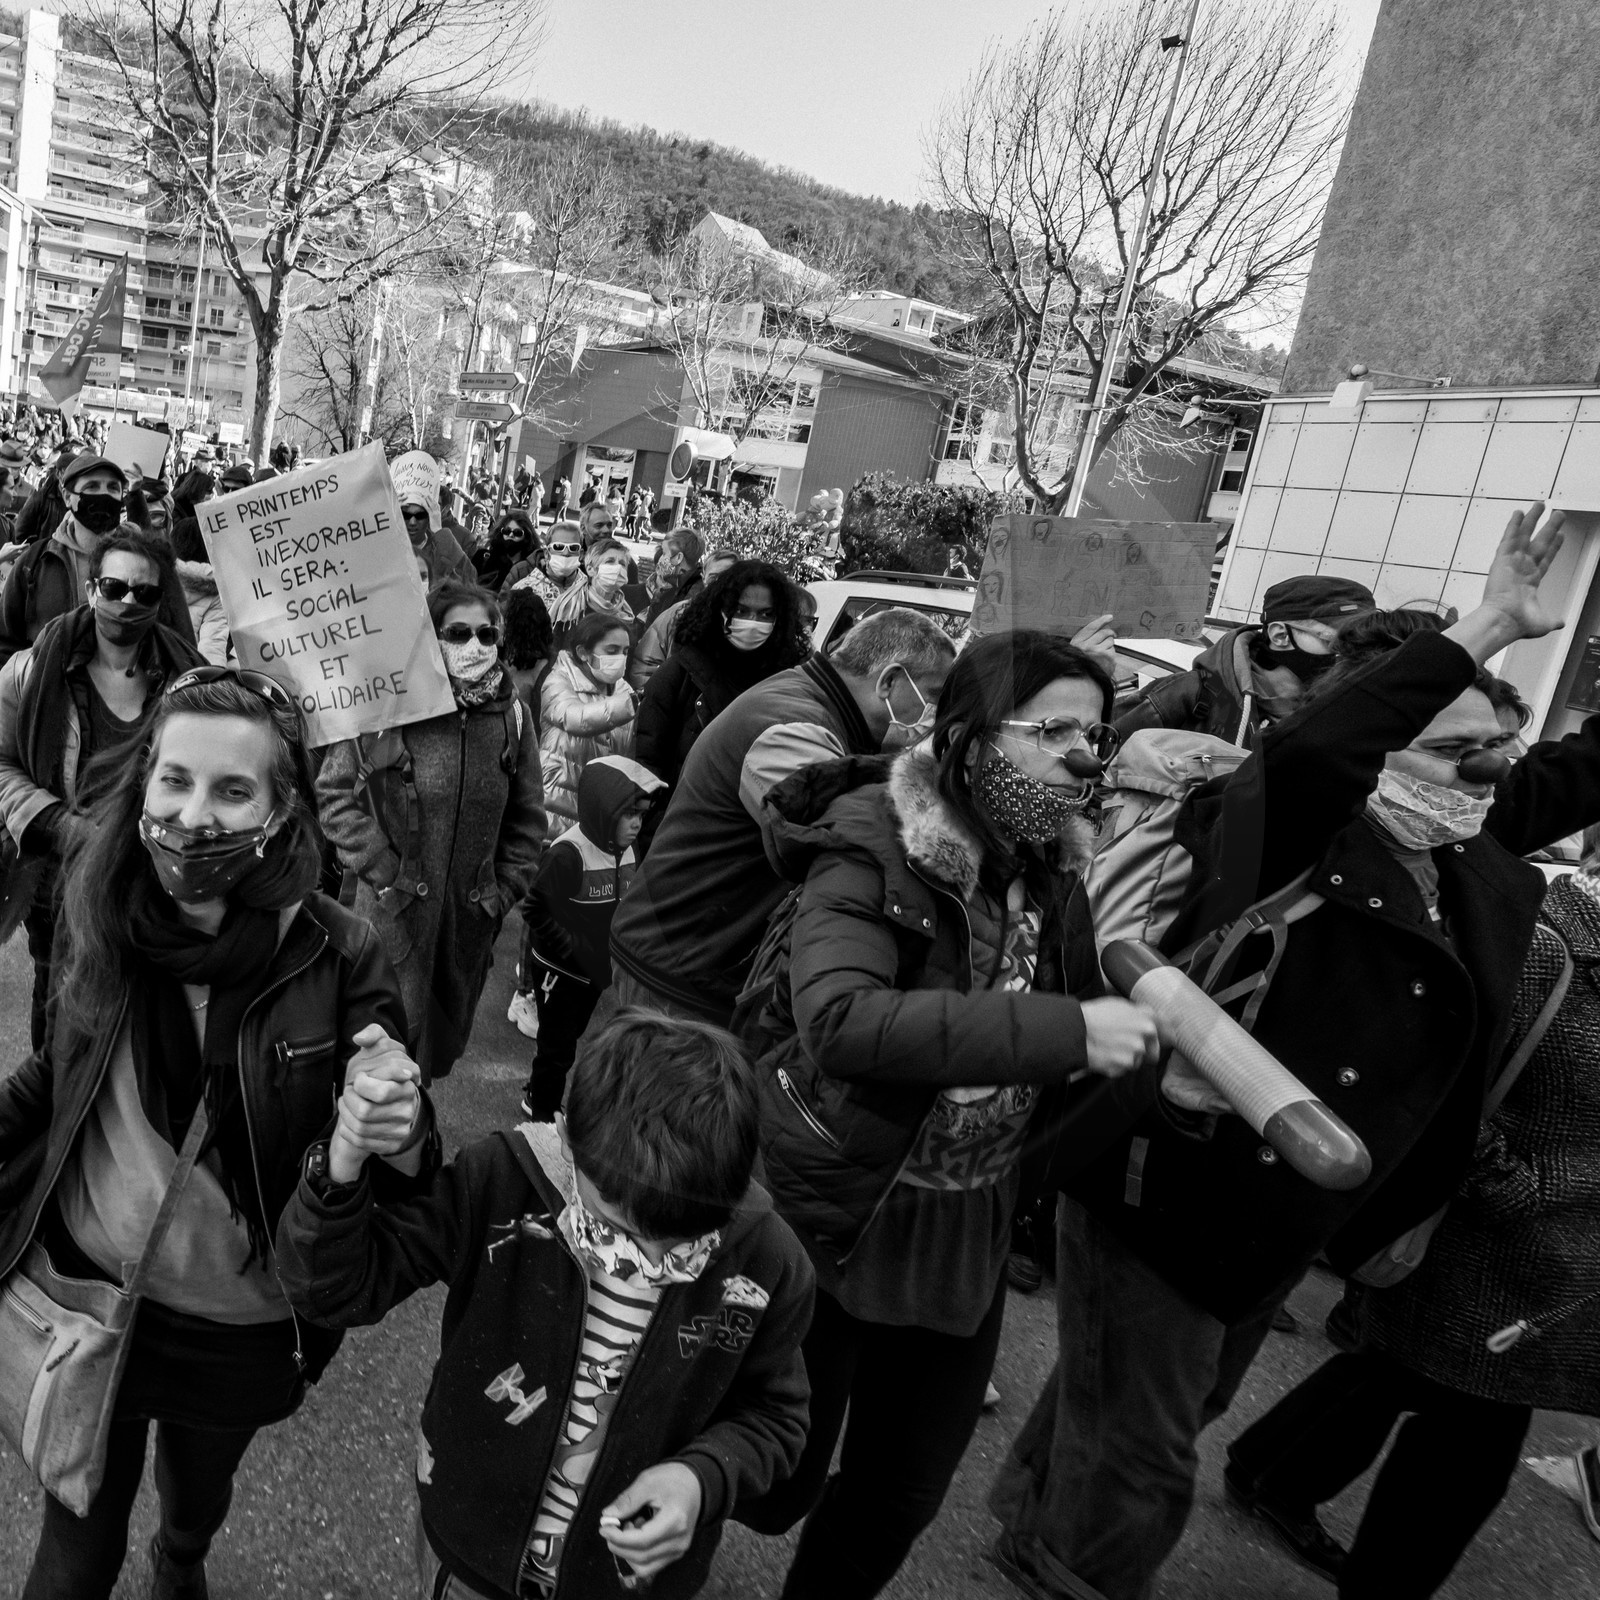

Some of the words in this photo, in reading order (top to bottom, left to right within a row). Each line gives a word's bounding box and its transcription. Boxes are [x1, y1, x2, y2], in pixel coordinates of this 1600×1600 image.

[60, 333, 84, 367] CGT
[207, 511, 228, 534] LE
[236, 474, 339, 523] PRINTEMPS
[249, 517, 291, 544] EST
[257, 511, 390, 567] INEXORABLE
[252, 578, 272, 600] IL
[280, 559, 349, 591] SERA:
[286, 583, 368, 621] SOCIAL
[259, 614, 382, 662] CULTUREL
[319, 654, 349, 680] ET
[292, 670, 408, 714] OLIDAIRE
